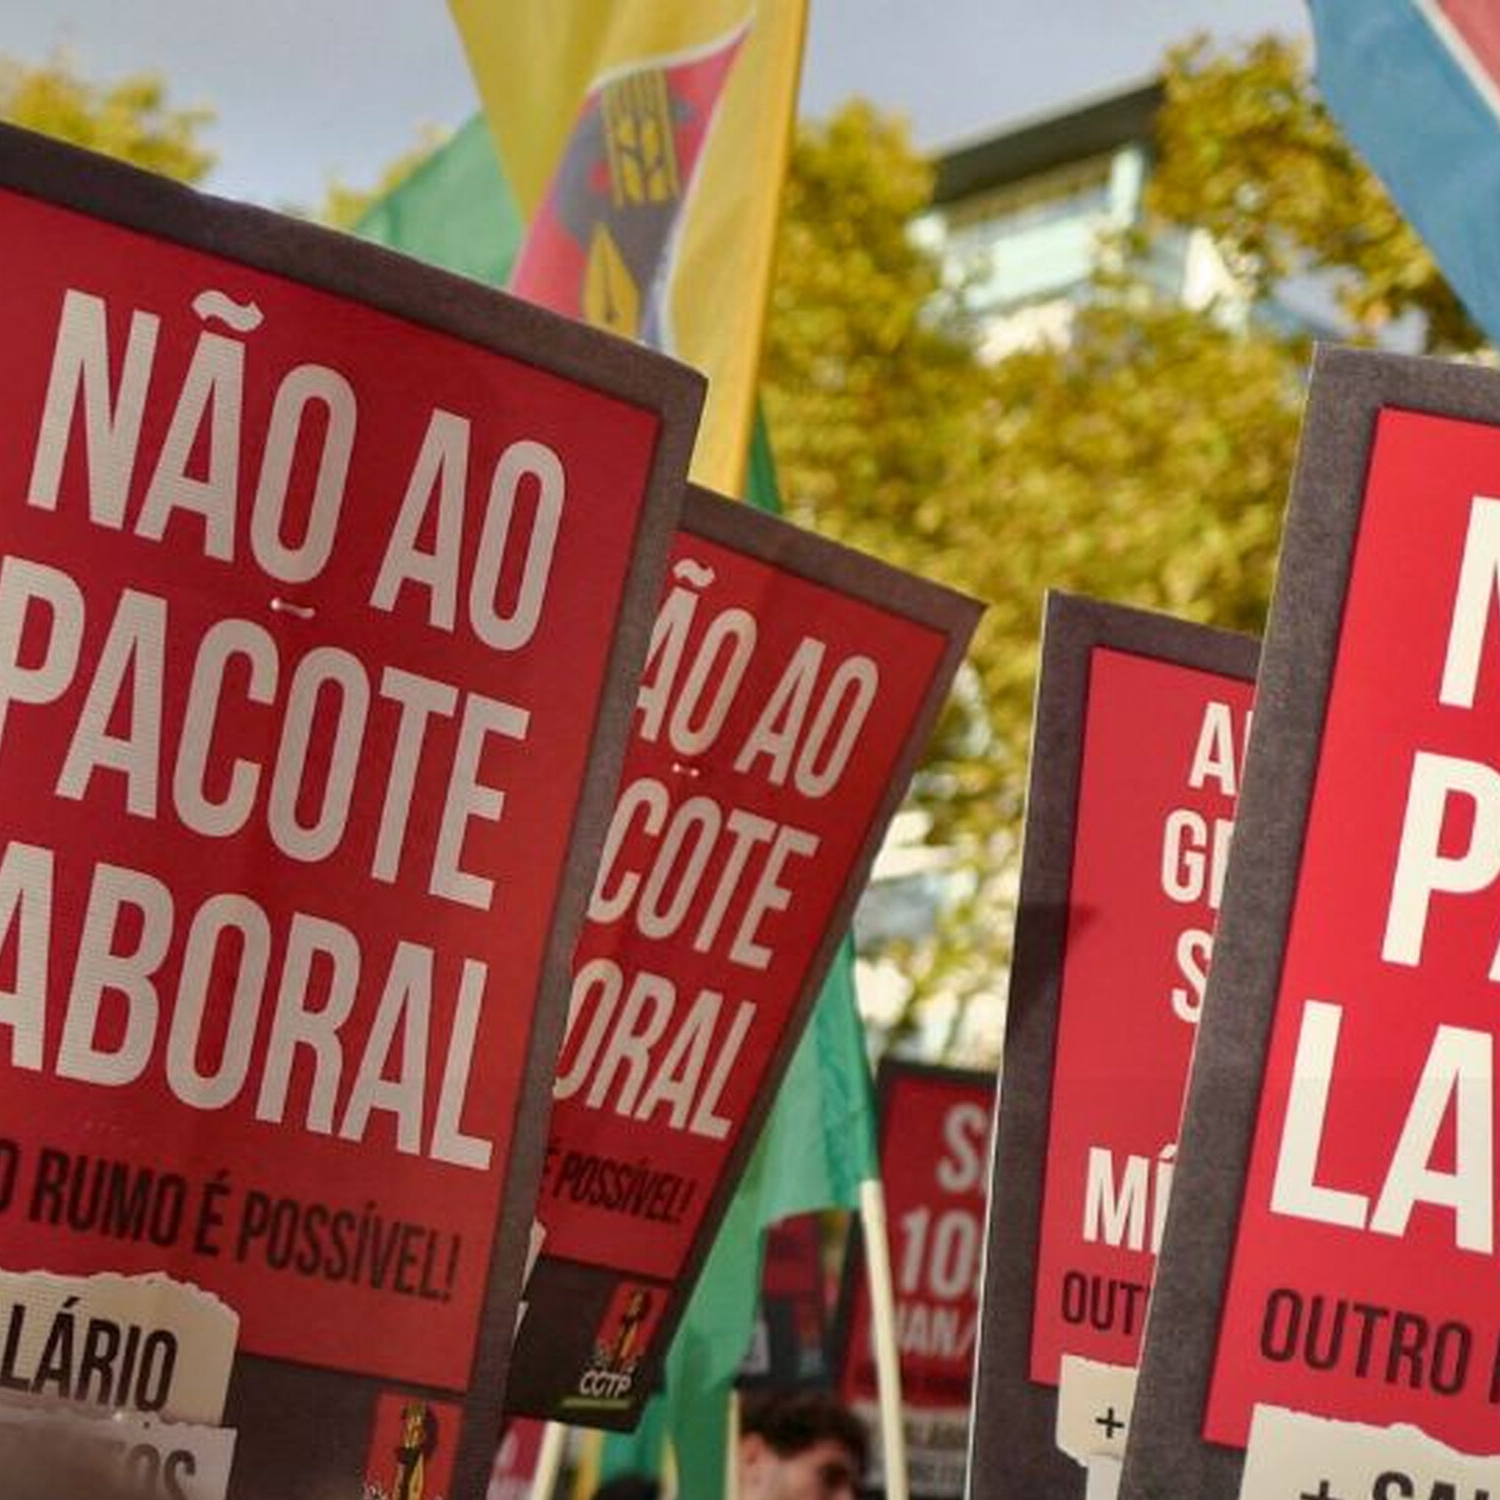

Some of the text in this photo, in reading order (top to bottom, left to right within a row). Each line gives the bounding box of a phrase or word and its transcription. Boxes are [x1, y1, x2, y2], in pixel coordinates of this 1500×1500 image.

[28, 285, 564, 650] NÃO AO
[734, 637, 878, 797] AO
[1189, 702, 1252, 796] A
[585, 778, 818, 968] COTE
[552, 959, 756, 1140] ORAL
[30, 1148, 184, 1247] RUMO
[193, 1171, 230, 1257] É
[236, 1188, 463, 1302] POSSÍVEL!
[553, 1149, 698, 1225] POSSÍVEL!
[1062, 1271, 1151, 1335] OUT
[1261, 1290, 1471, 1395] OUTRO
